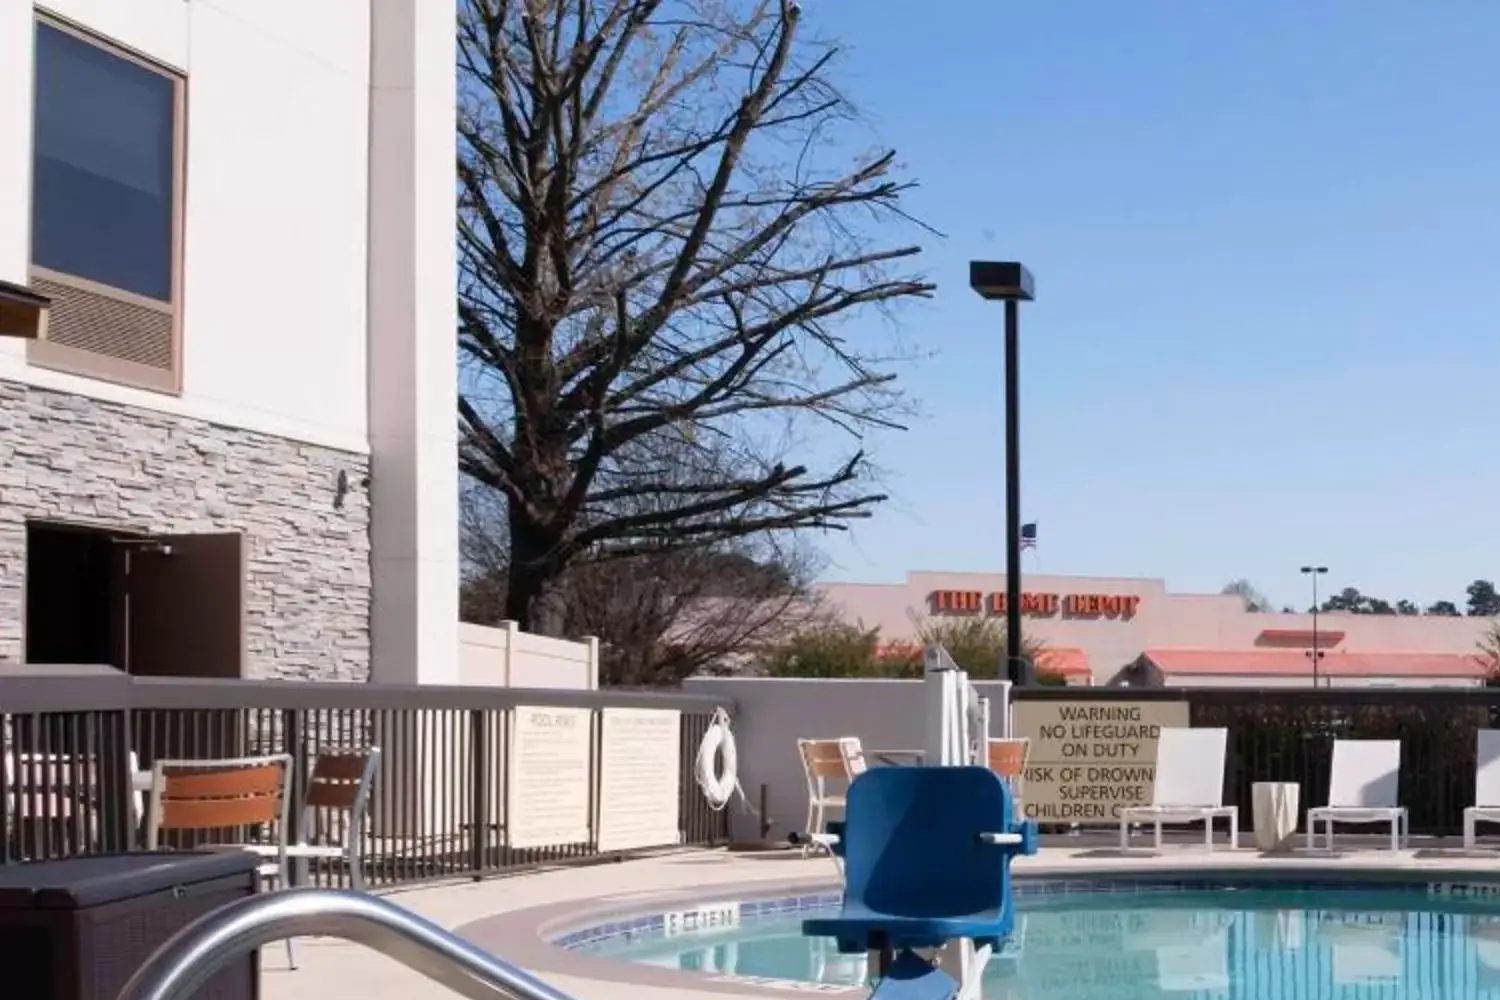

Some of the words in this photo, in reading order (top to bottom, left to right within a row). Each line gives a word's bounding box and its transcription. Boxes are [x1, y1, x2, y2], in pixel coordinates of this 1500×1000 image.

[935, 590, 981, 610] THE
[992, 592, 1059, 614] HME
[1059, 706, 1141, 721] WARNING
[1039, 725, 1067, 739] NO
[1071, 725, 1160, 739] LIFEGUARD
[1062, 743, 1087, 757] ON
[1093, 743, 1140, 757] DUTY
[1060, 767, 1081, 782] OF
[1058, 785, 1144, 800] SUPERVISE
[1024, 803, 1105, 818] CHILDREN
